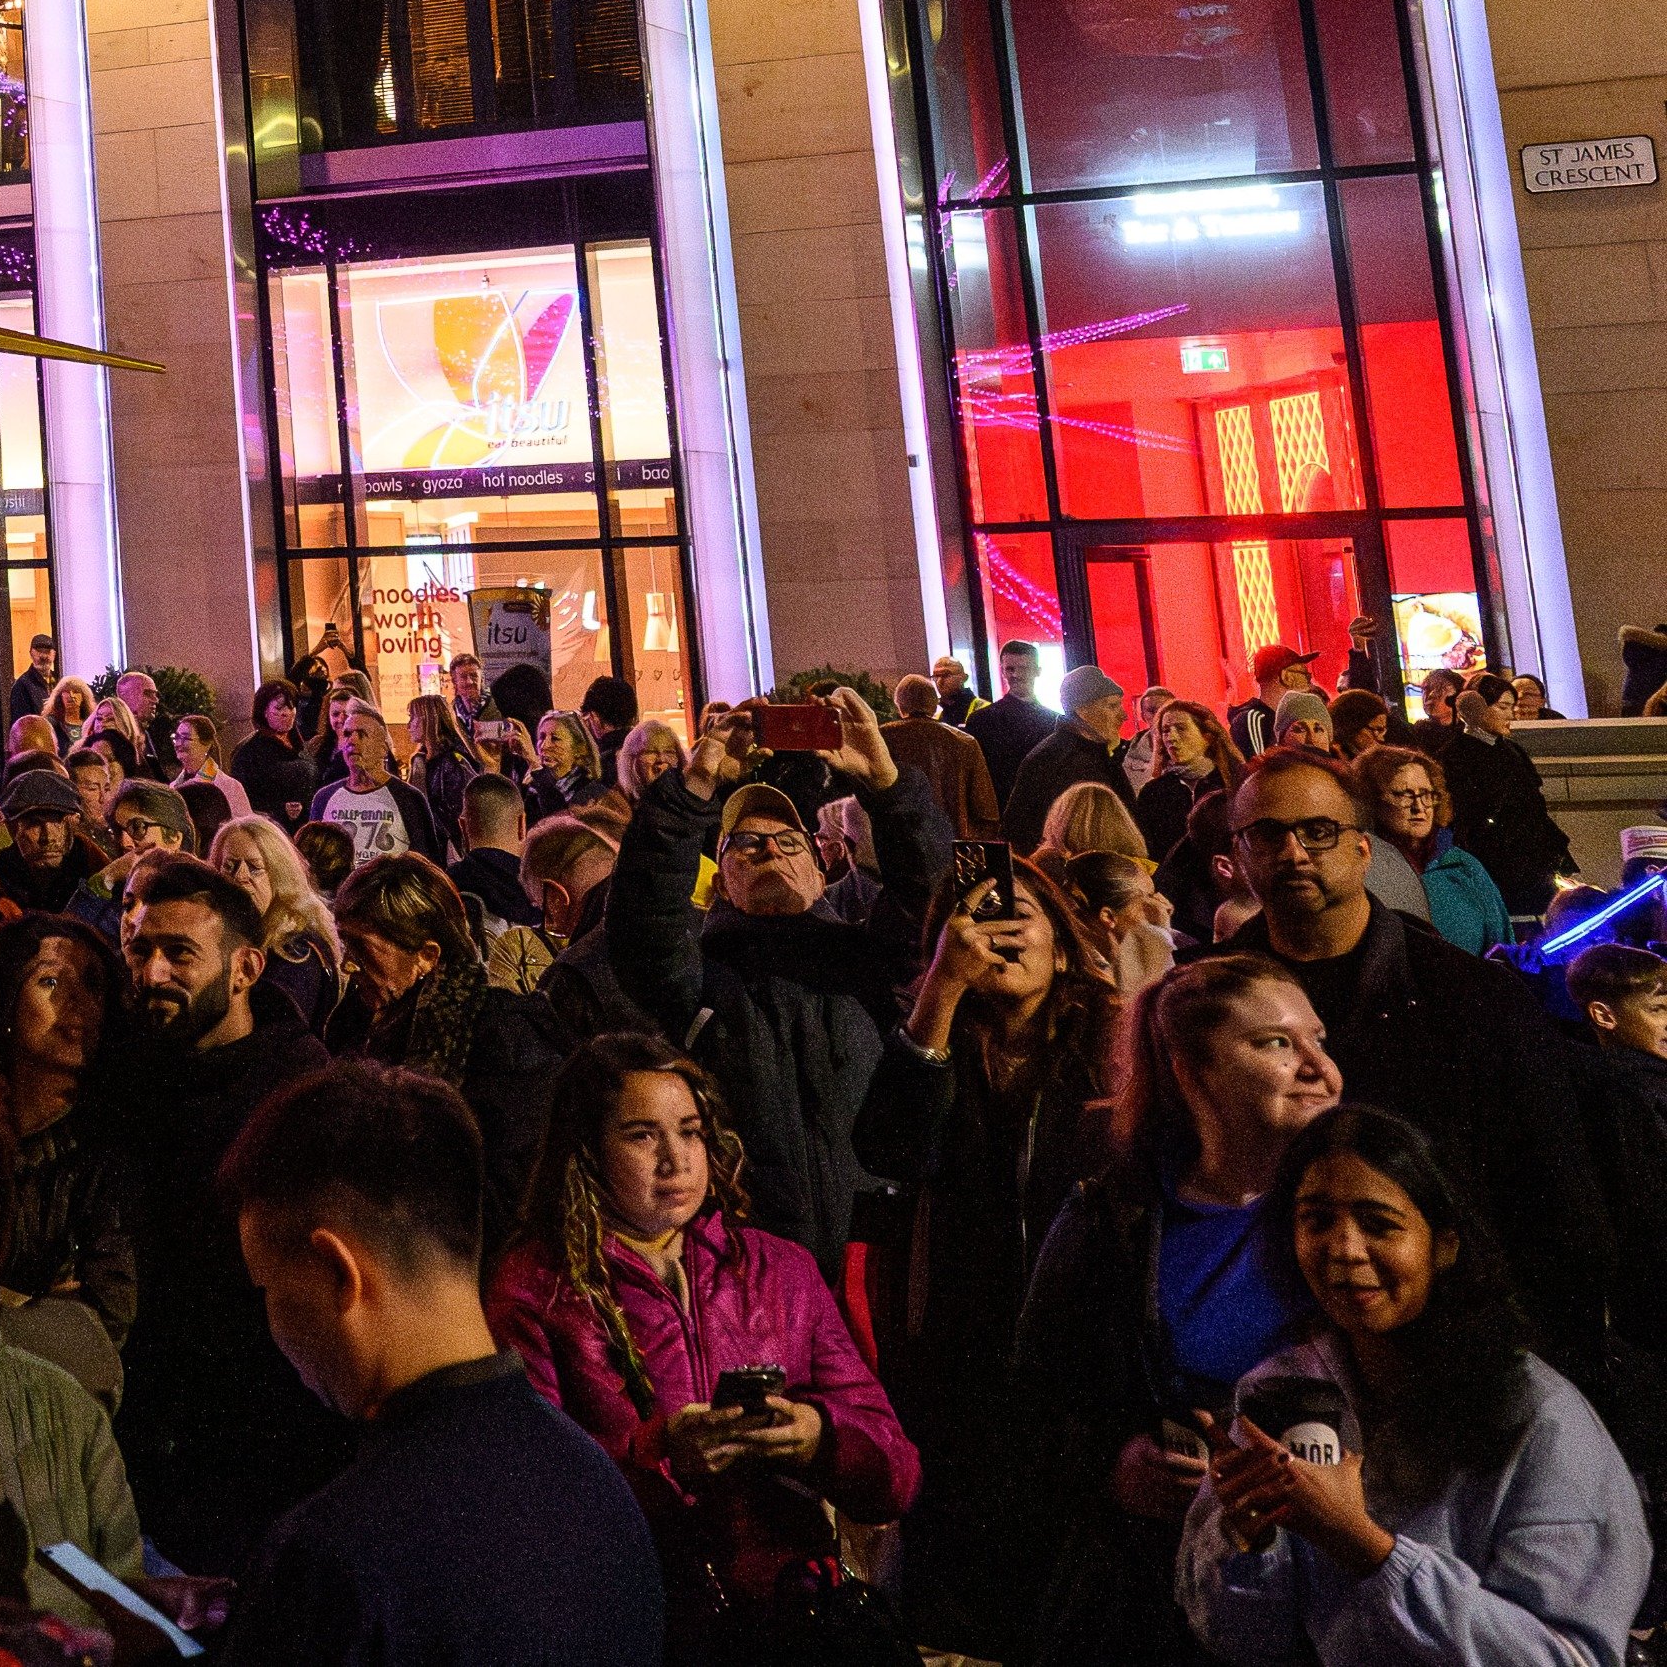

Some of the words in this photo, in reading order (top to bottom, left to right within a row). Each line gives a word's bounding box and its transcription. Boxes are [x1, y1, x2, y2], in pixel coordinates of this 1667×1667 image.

[1540, 149, 1563, 165] ST
[1571, 143, 1635, 163] JAMES
[1535, 164, 1644, 186] CRESCENT
[422, 475, 463, 494] gyoza
[482, 470, 505, 488] hot
[509, 466, 563, 486] noodles
[642, 463, 670, 481] bao
[372, 582, 460, 605] noodles
[374, 606, 442, 631] worth
[487, 622, 528, 646] itsu
[377, 637, 443, 659] loving
